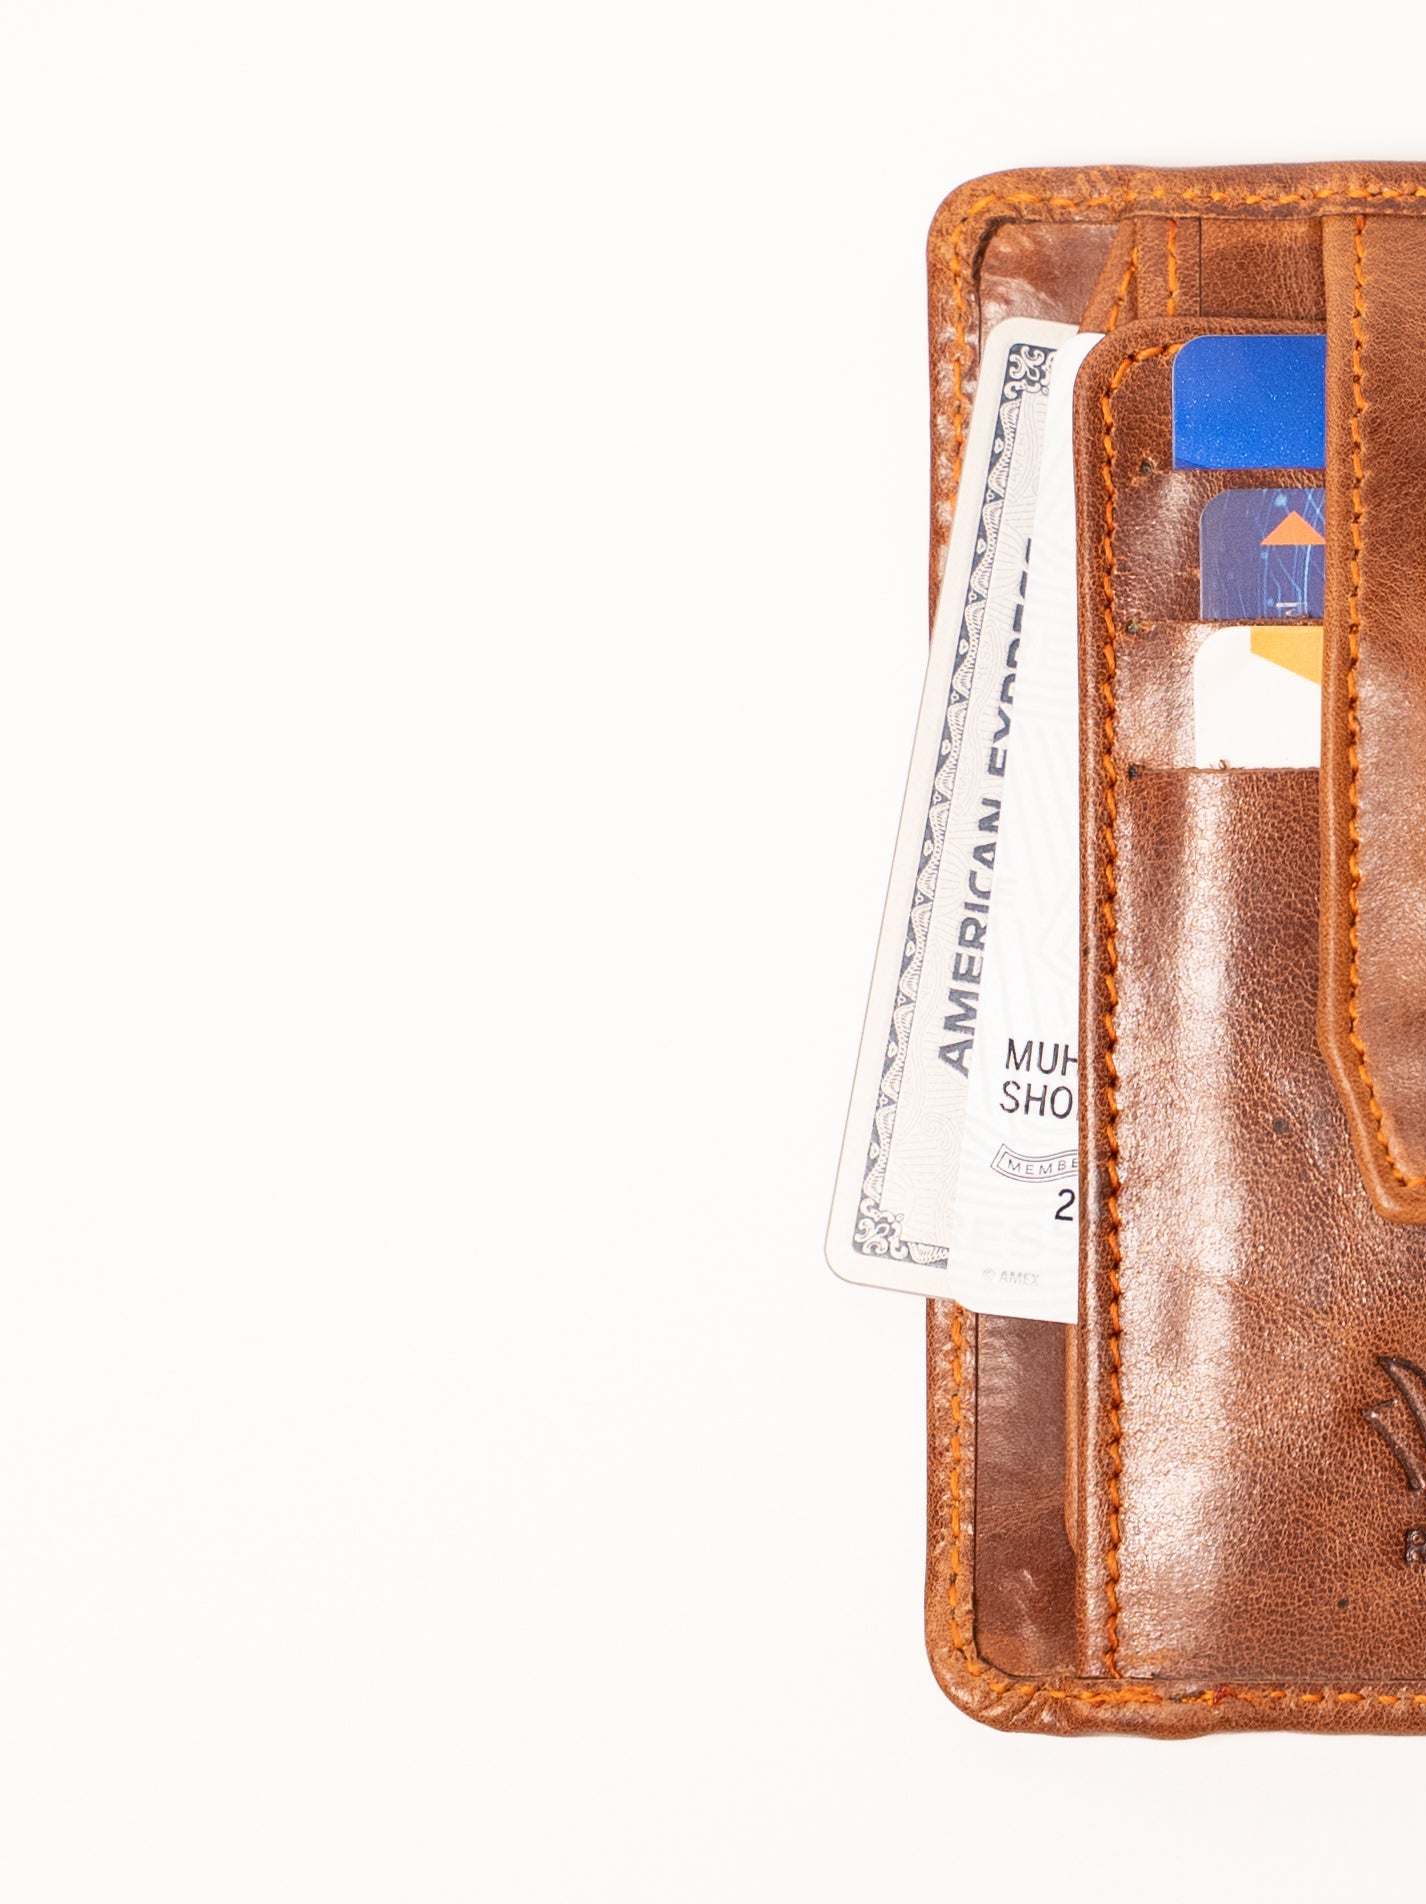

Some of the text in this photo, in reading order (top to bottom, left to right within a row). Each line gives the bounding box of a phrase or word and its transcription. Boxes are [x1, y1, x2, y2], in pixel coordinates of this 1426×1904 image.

[938, 797, 1002, 1079] AMERICAN
[1000, 1080, 1078, 1120] SHO
[1054, 1189, 1076, 1221] 2
[999, 1269, 1040, 1287] AMEX
